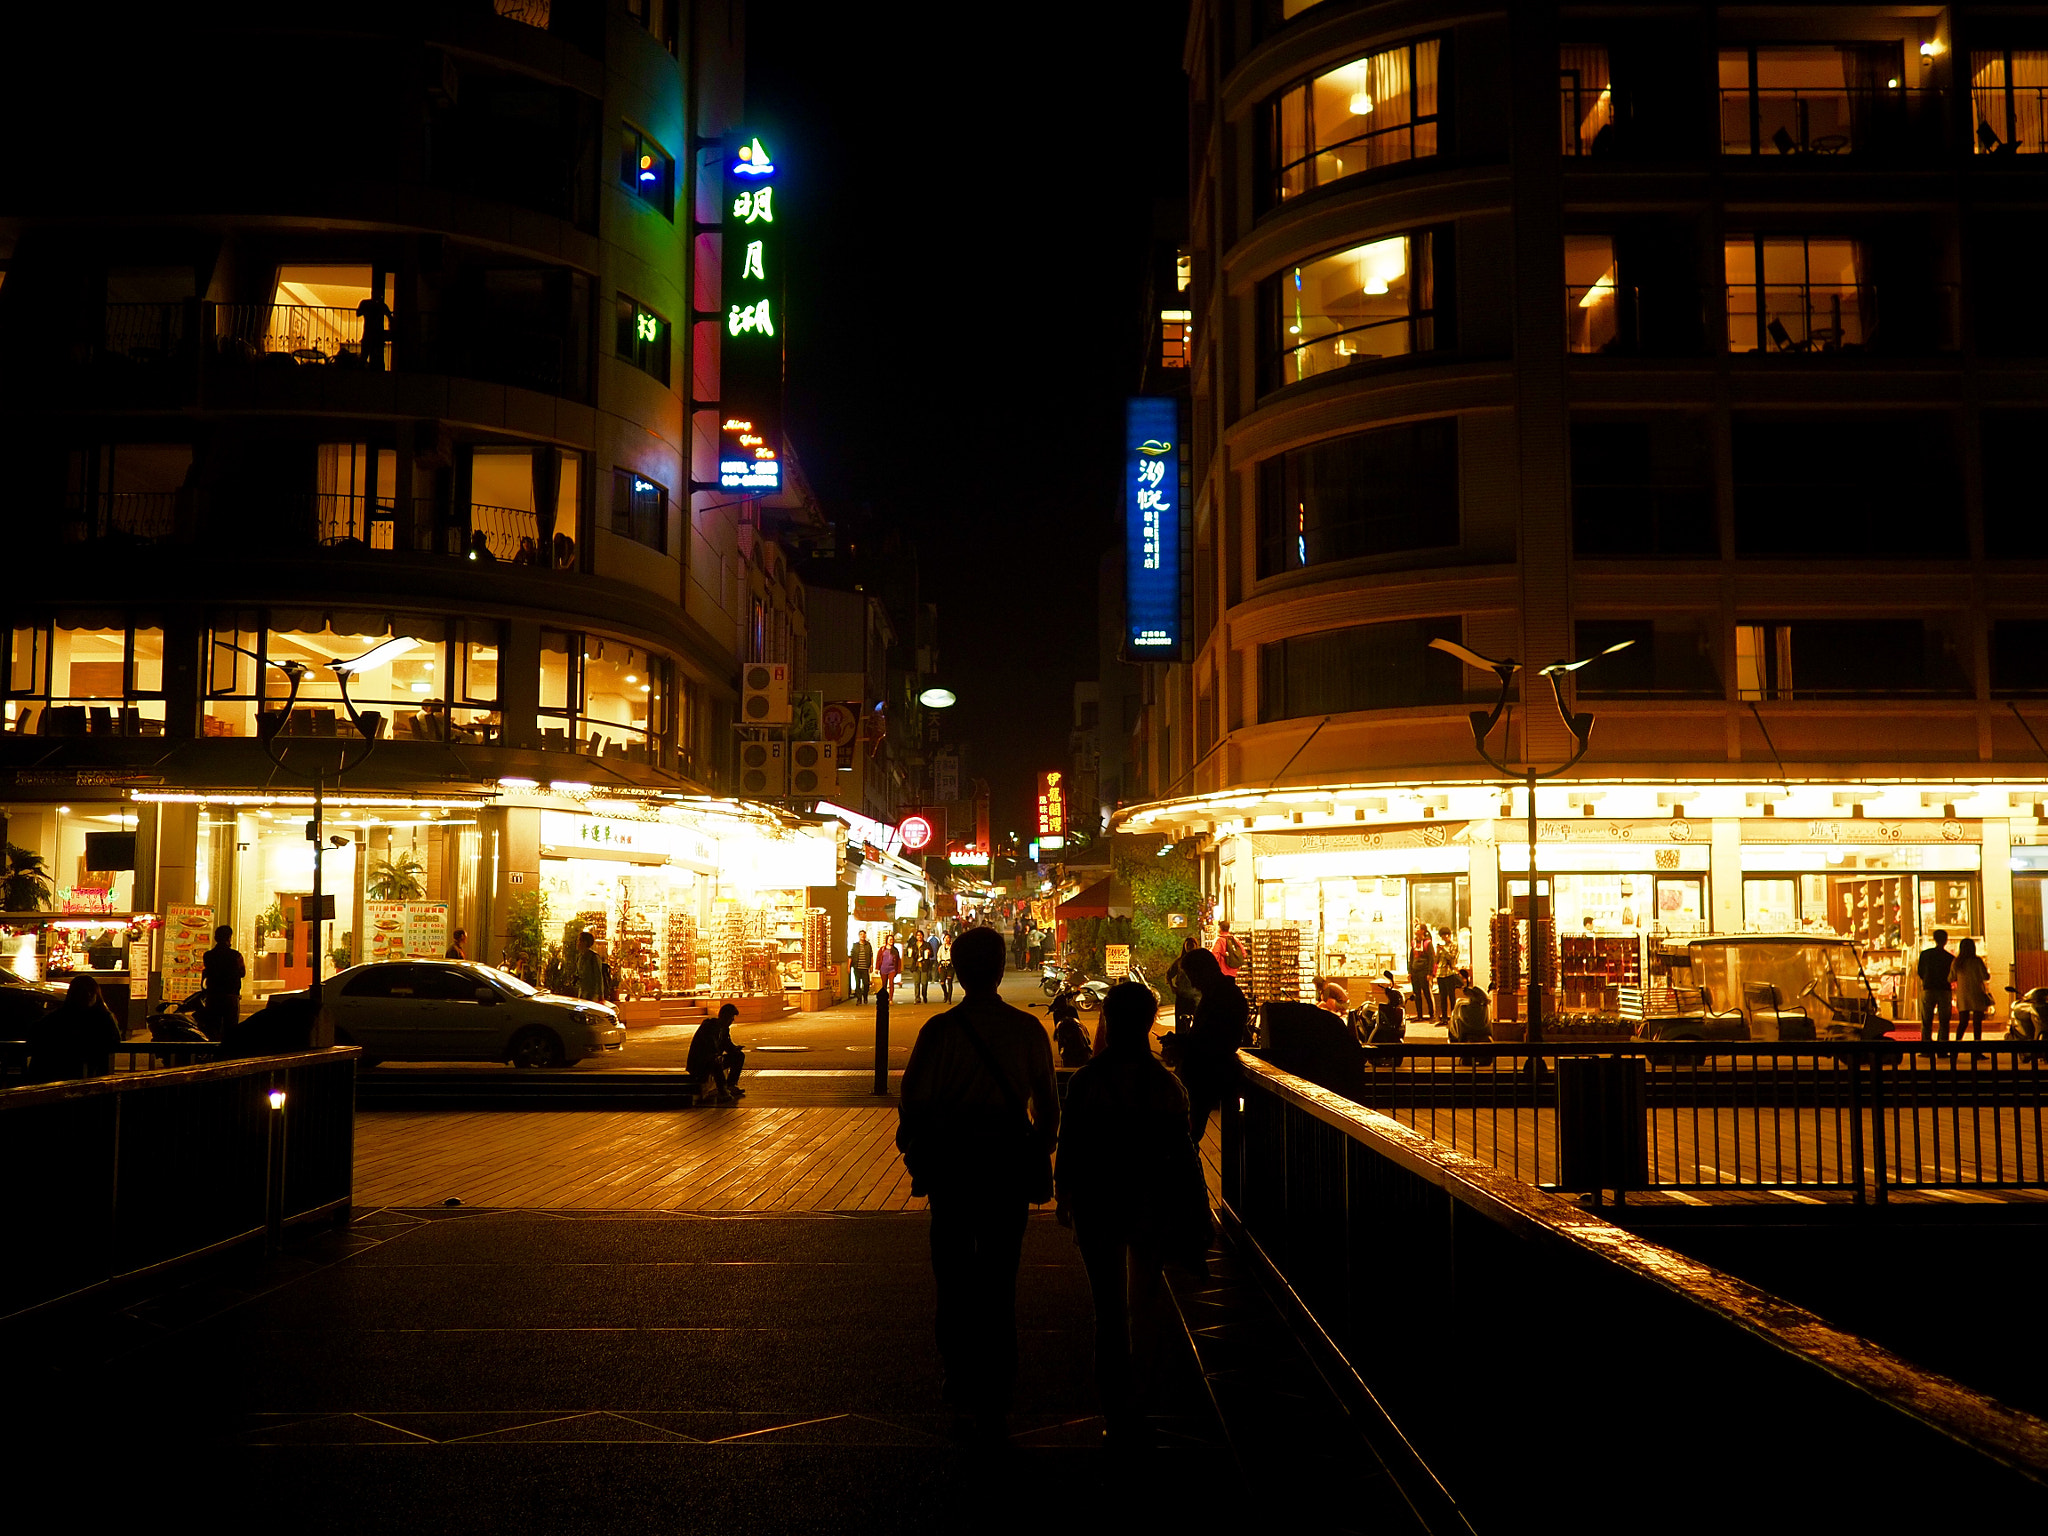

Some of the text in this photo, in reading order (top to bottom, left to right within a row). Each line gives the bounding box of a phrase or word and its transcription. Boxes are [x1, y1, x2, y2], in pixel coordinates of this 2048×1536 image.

[728, 186, 774, 337] 明月湖
[1137, 459, 1170, 511] 湖悅
[580, 823, 612, 844] 幸運草
